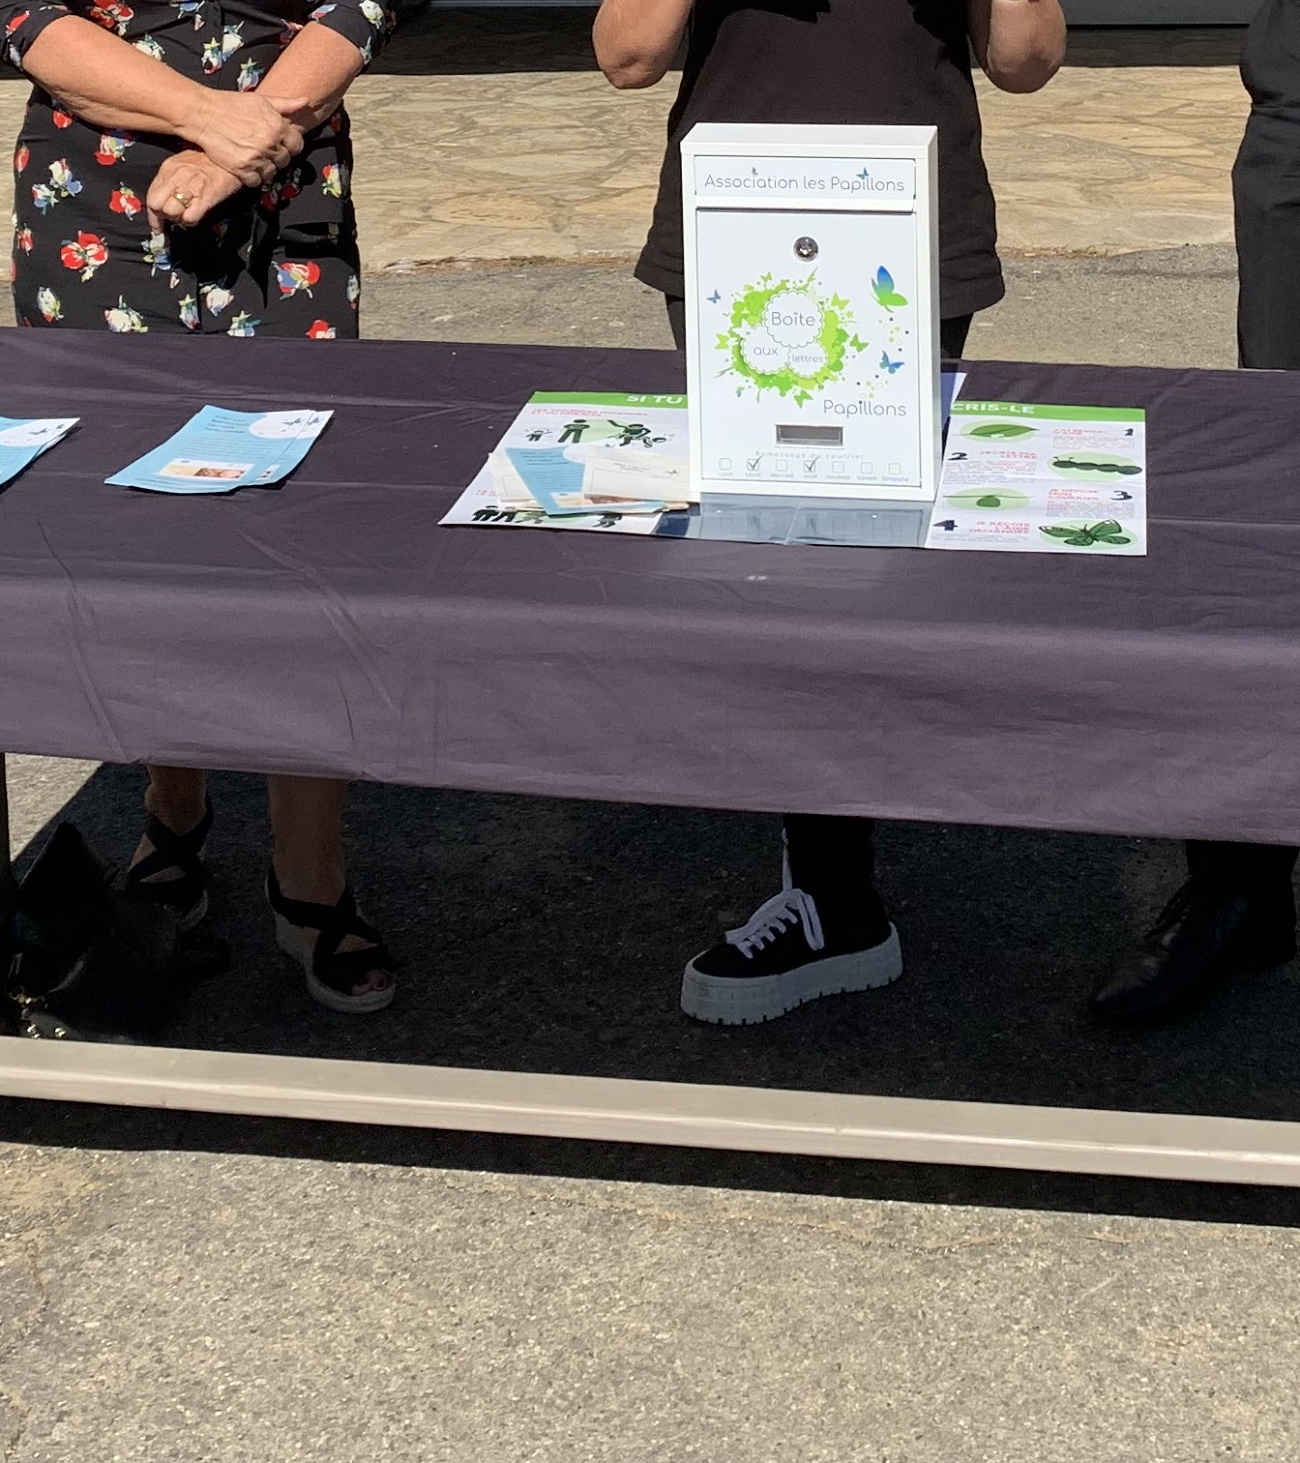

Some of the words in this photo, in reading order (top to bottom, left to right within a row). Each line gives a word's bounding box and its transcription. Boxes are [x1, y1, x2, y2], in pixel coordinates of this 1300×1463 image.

[704, 173, 798, 189] Association
[803, 175, 826, 190] les
[830, 174, 905, 194] Papillons
[771, 312, 816, 327] Boîte
[753, 345, 779, 356] aux
[791, 353, 824, 364] lettres
[823, 399, 907, 418] Papillons
[947, 452, 968, 460] 2
[1110, 490, 1133, 501] 3
[933, 519, 958, 531] 4
